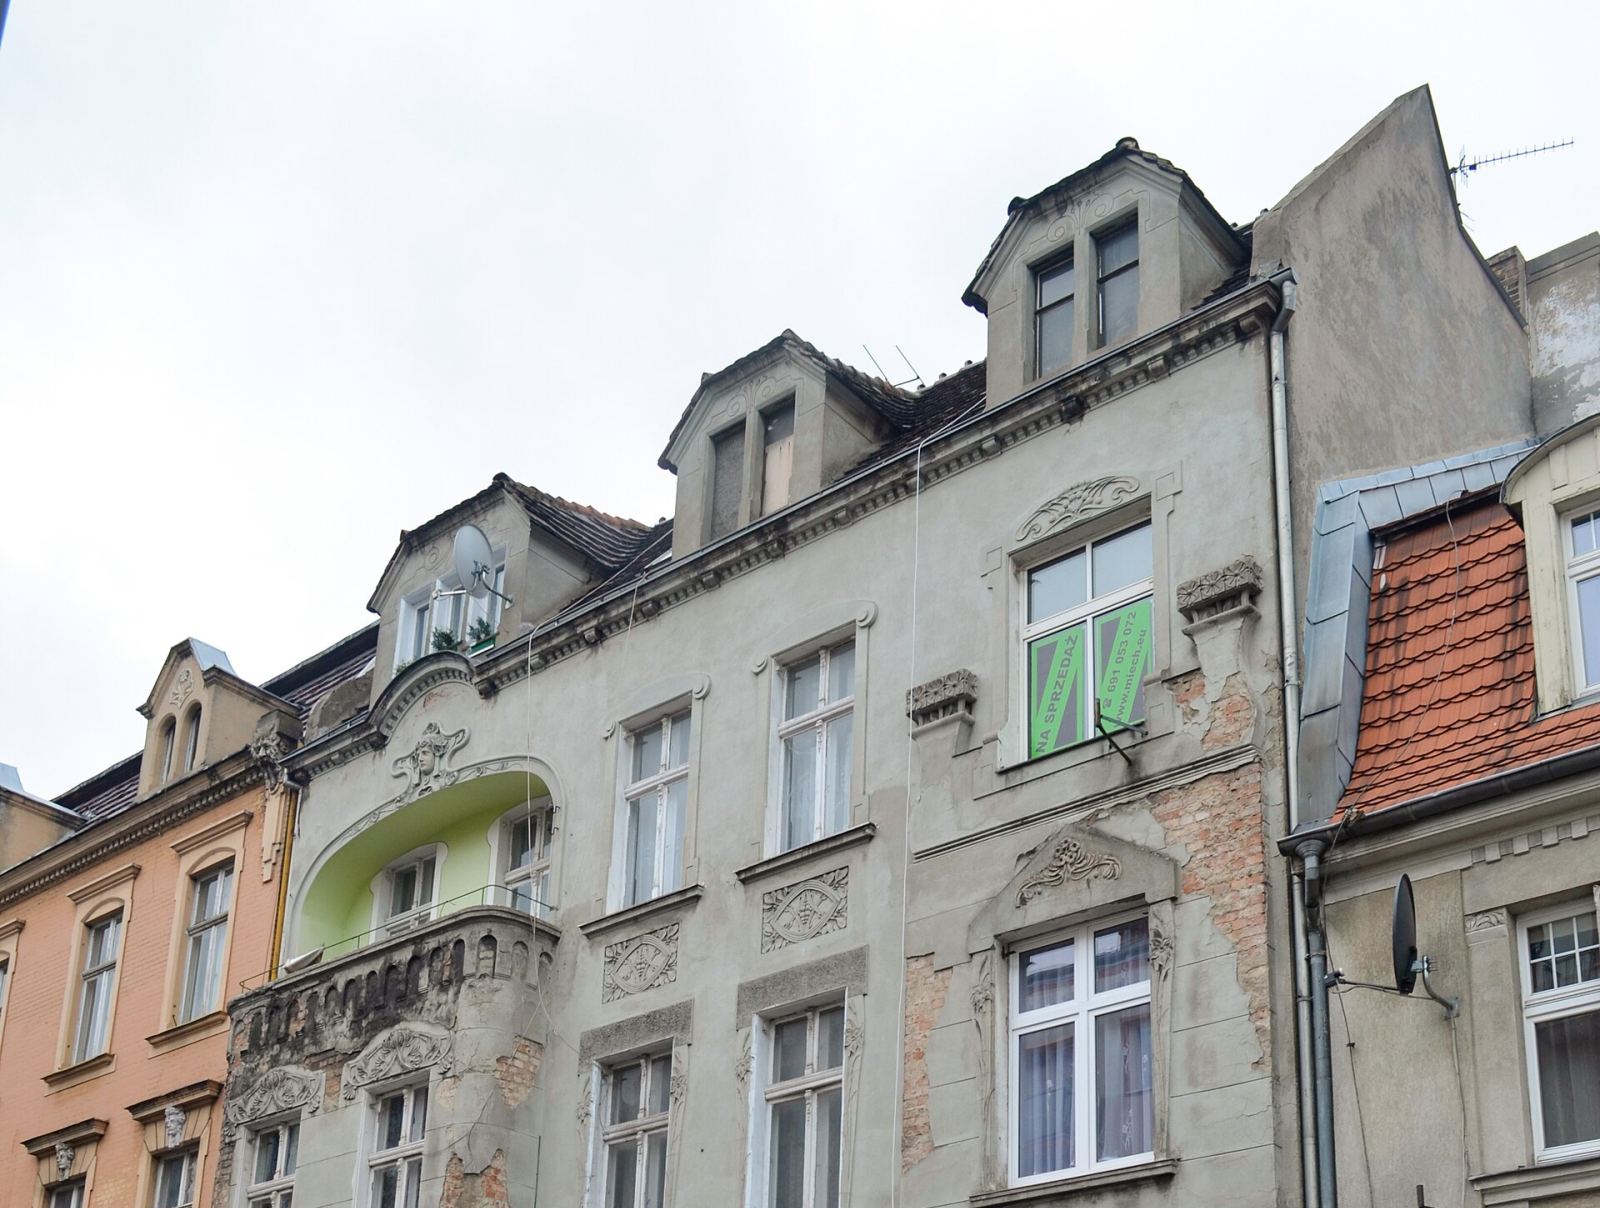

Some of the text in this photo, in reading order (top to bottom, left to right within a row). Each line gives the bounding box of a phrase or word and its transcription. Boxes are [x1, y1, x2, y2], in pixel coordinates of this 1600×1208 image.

[1035, 634, 1079, 753] NA SPRZEDAŻ
[1107, 611, 1137, 693] 691 053 072
